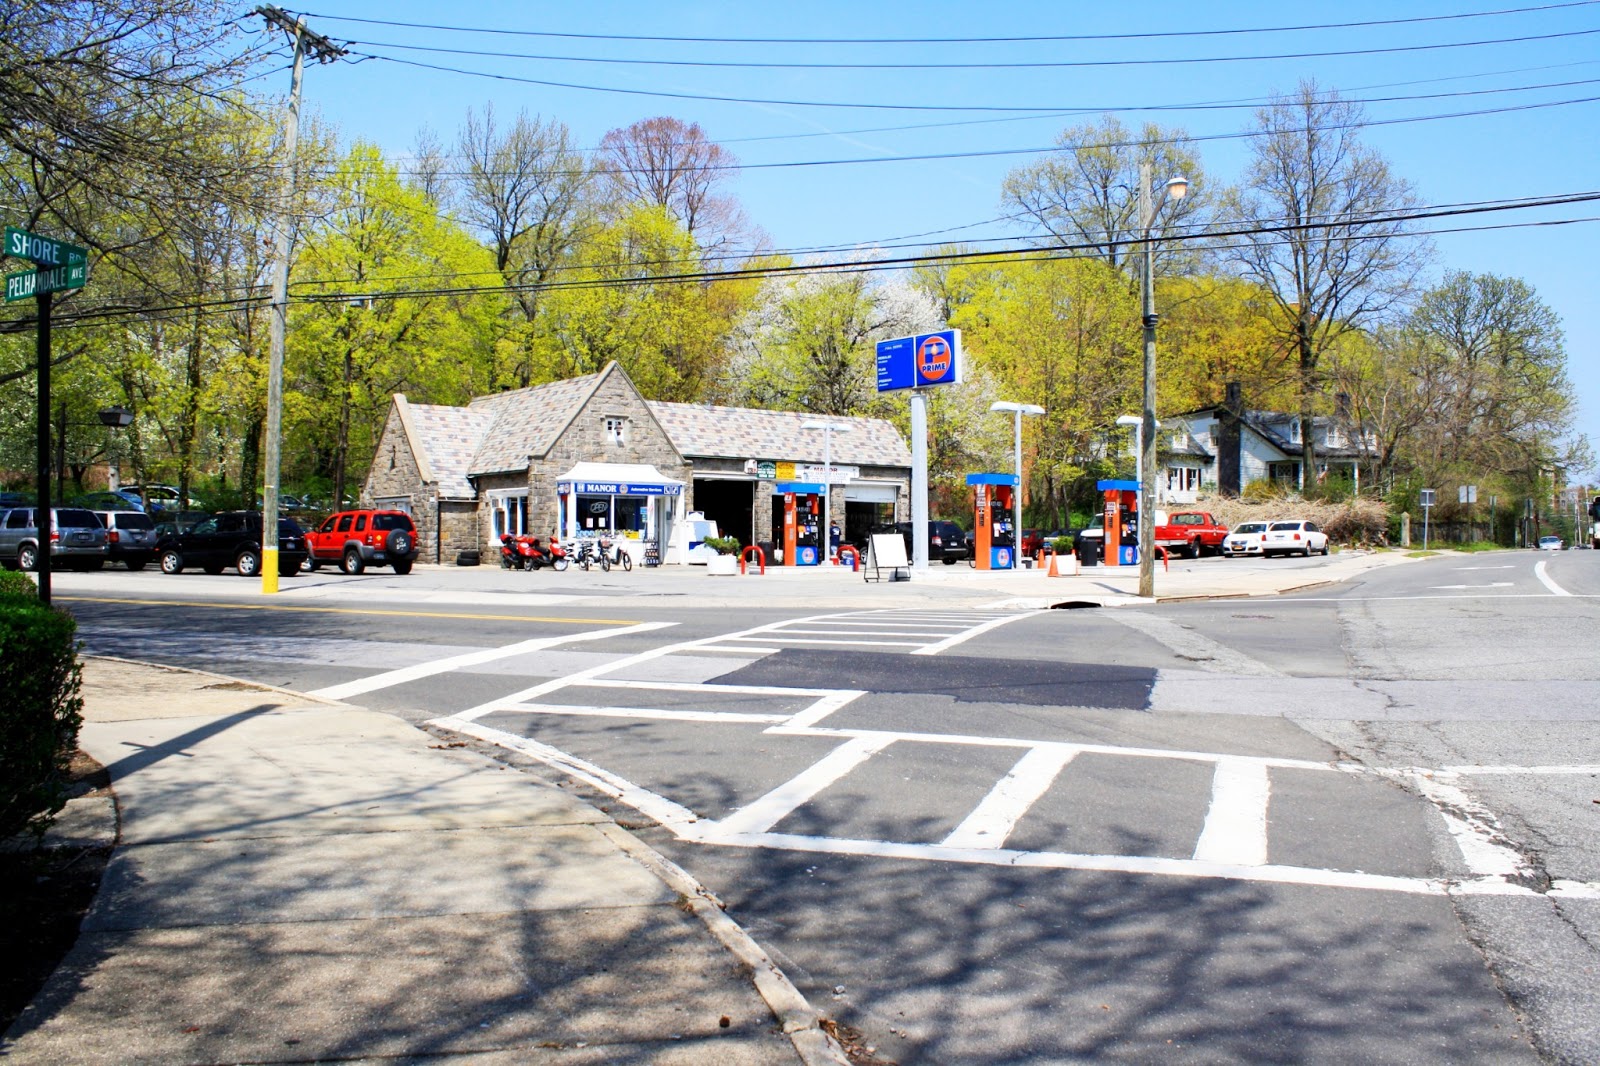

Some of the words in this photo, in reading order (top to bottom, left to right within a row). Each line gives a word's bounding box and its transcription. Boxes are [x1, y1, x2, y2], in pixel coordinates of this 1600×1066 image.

[12, 232, 60, 264] SHORE
[9, 266, 66, 298] PELHAMDALE
[72, 267, 82, 280] AVE
[922, 363, 946, 372] PRIME
[587, 484, 616, 492] MANOR
